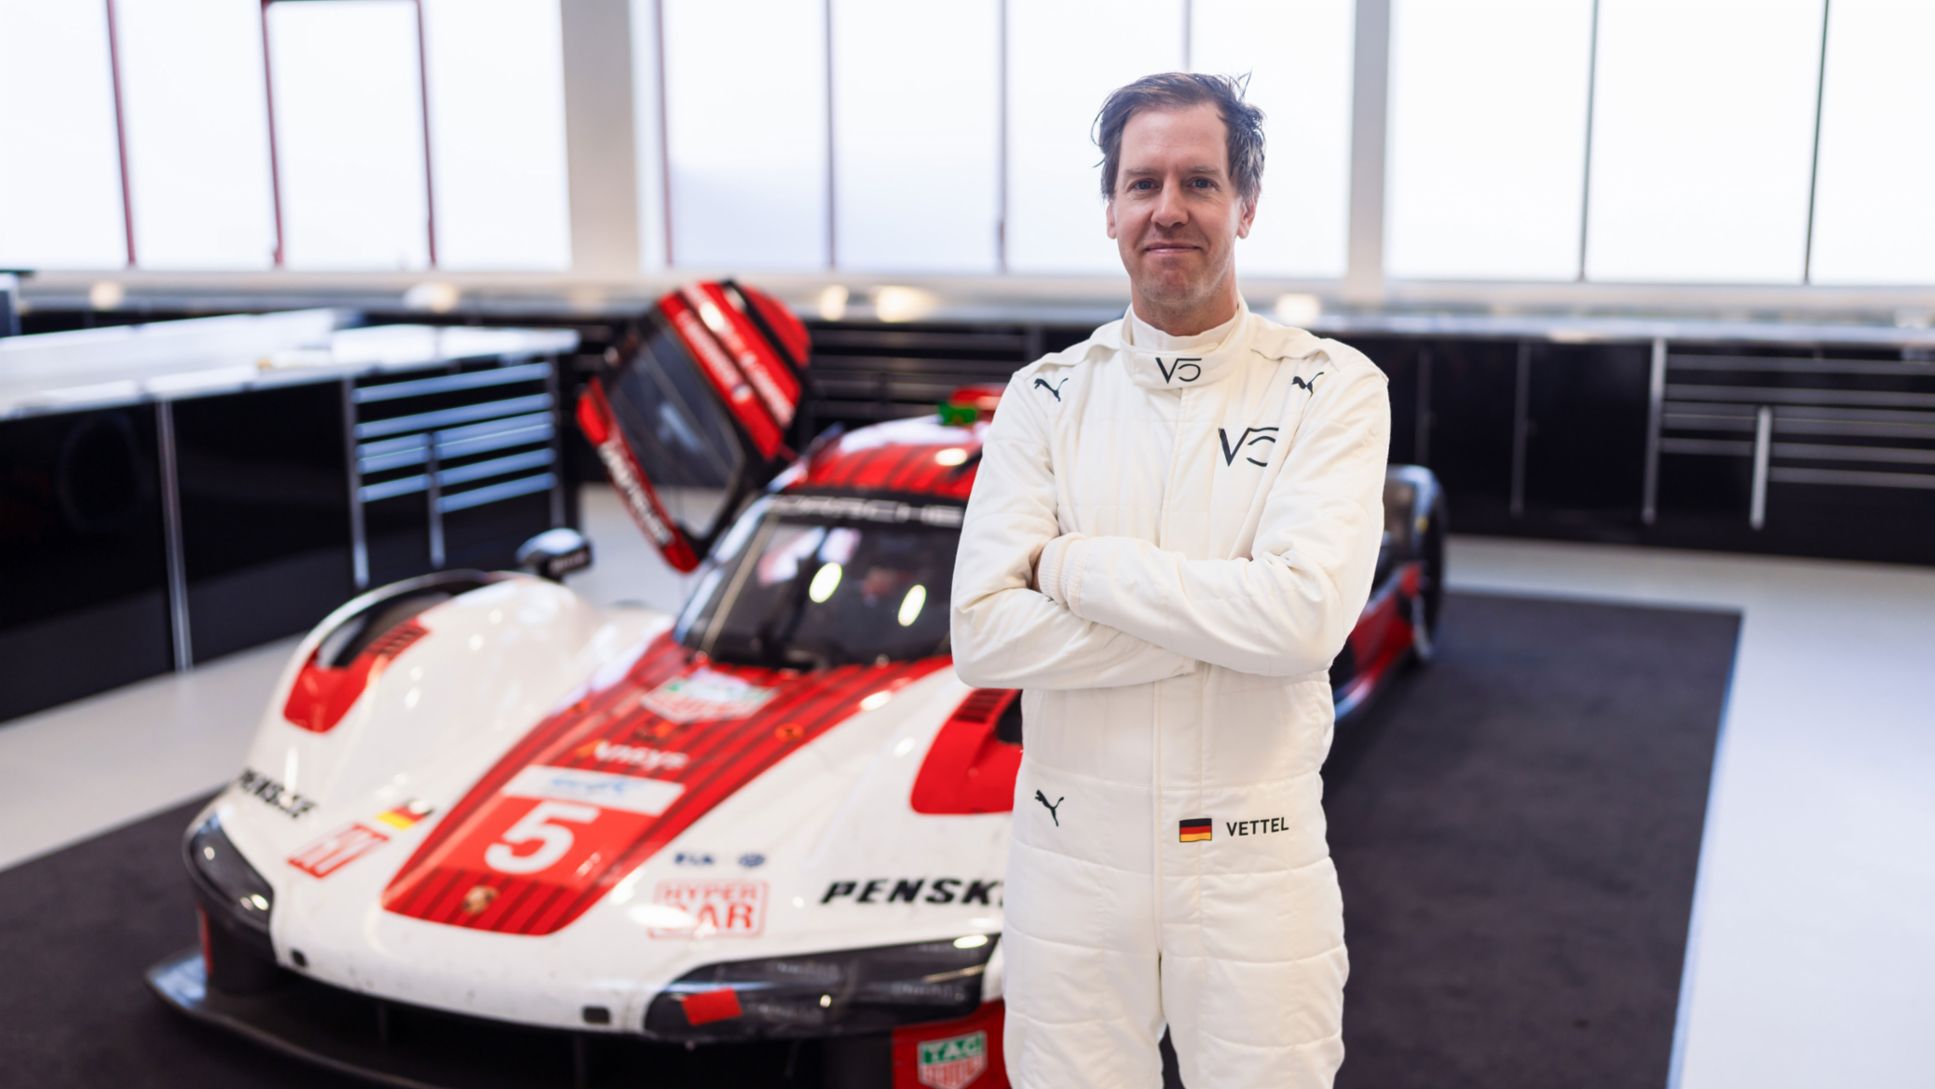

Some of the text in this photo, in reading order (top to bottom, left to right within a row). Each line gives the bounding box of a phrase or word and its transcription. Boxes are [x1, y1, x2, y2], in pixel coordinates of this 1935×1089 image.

[485, 802, 599, 874] 5
[1226, 817, 1289, 836] VETTEL
[820, 878, 1003, 907] PENSK
[670, 903, 753, 929] AR
